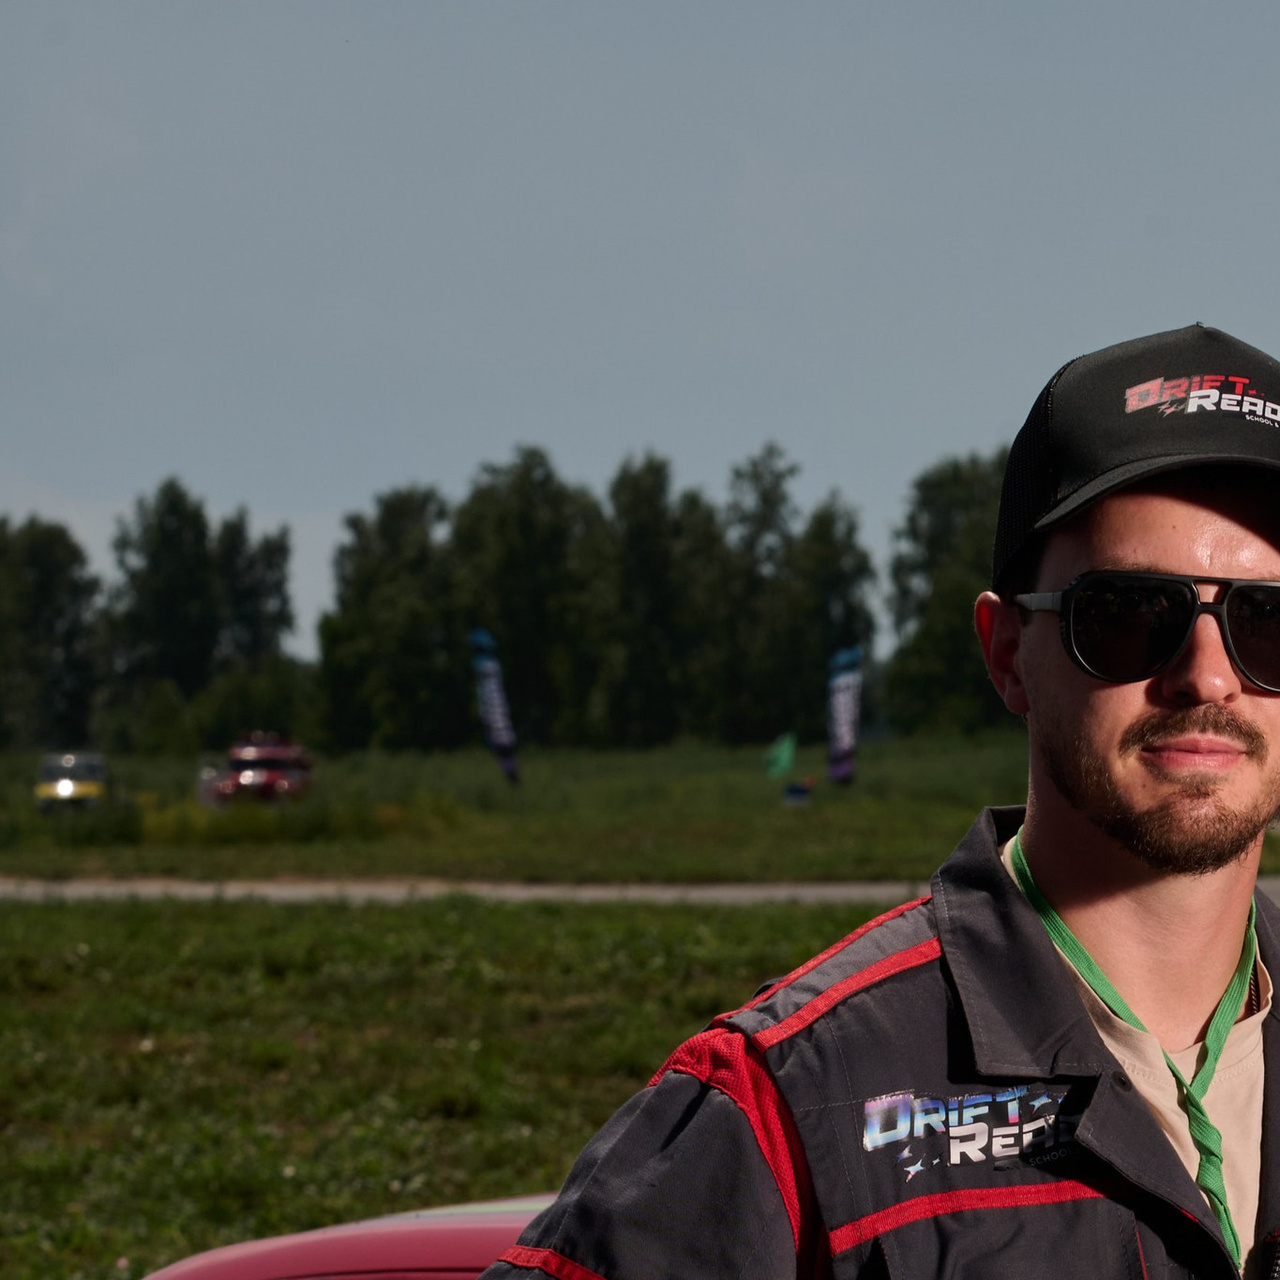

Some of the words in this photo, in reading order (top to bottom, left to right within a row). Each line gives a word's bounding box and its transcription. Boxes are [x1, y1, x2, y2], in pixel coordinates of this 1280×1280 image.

[1125, 375, 1250, 413] DRIFT
[1245, 414, 1273, 426] SCHOOL
[863, 1085, 1029, 1151] DRIFT
